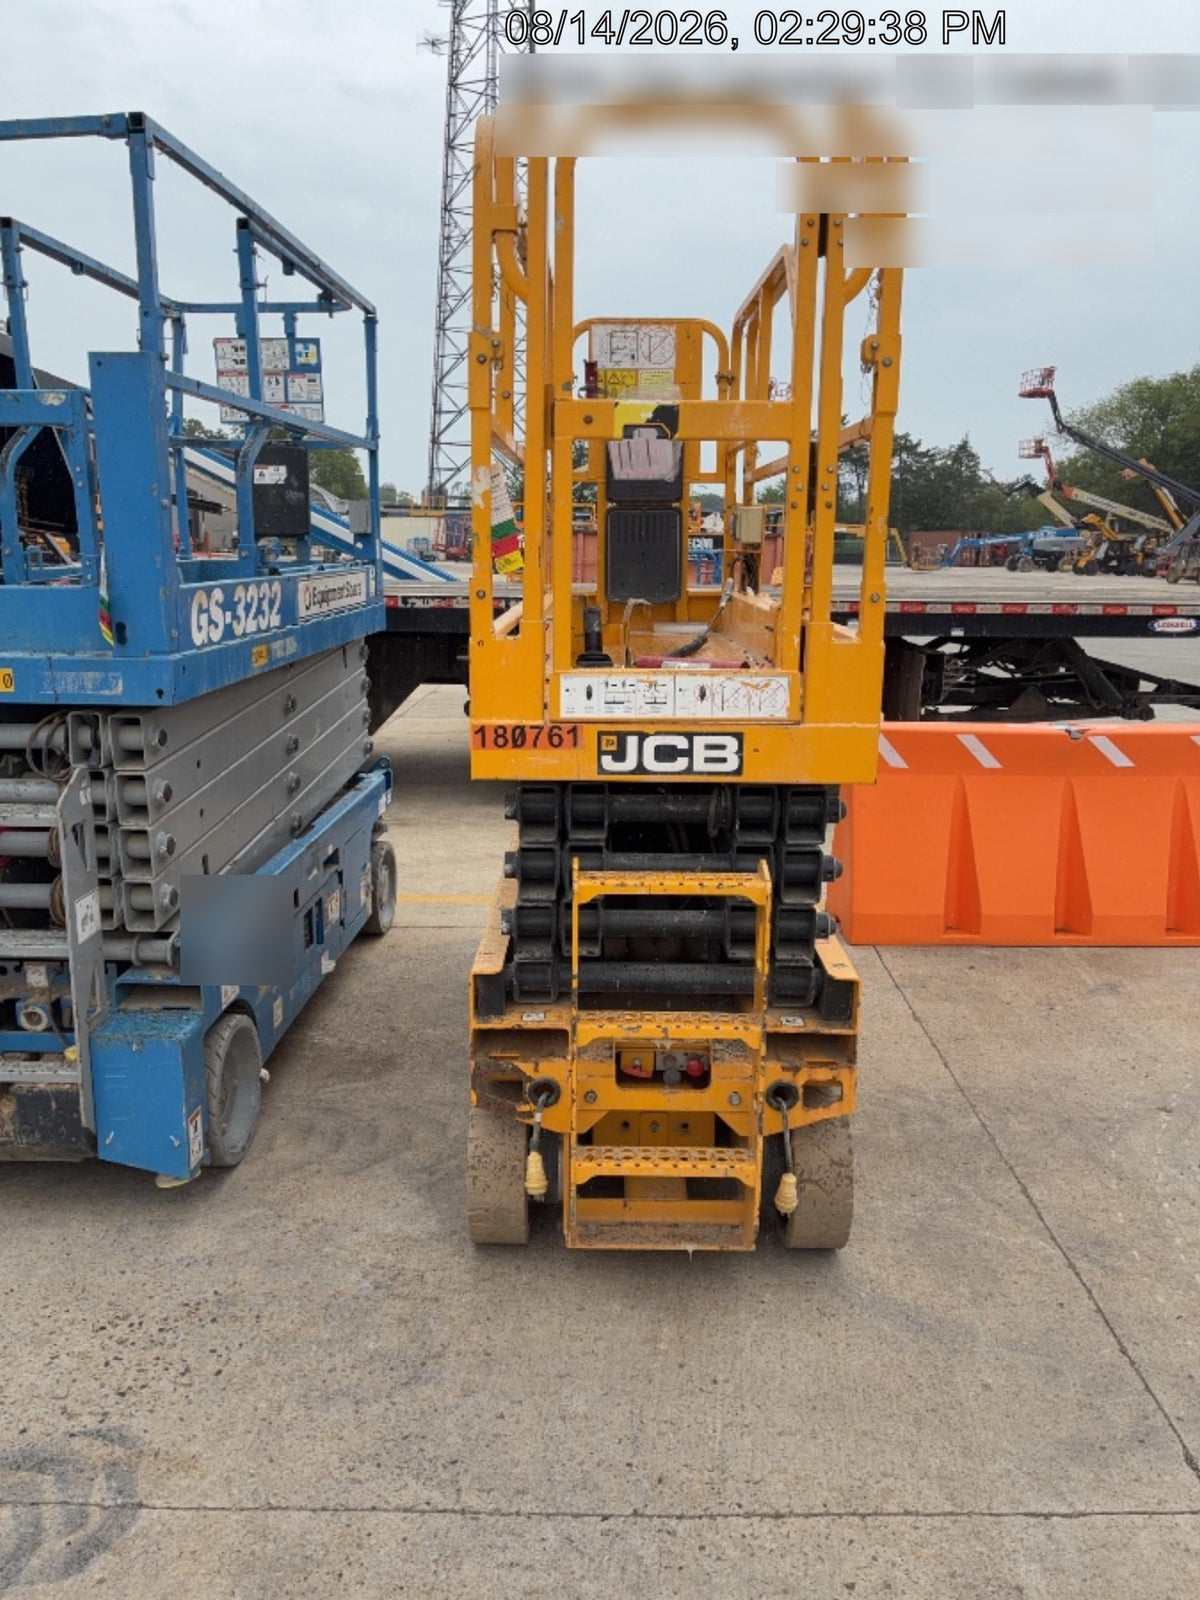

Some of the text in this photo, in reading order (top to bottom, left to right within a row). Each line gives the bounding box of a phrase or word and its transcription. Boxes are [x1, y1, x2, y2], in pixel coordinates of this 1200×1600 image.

[190, 580, 282, 647] GS-3232
[473, 725, 579, 749] 180761
[601, 735, 741, 773] JCB
